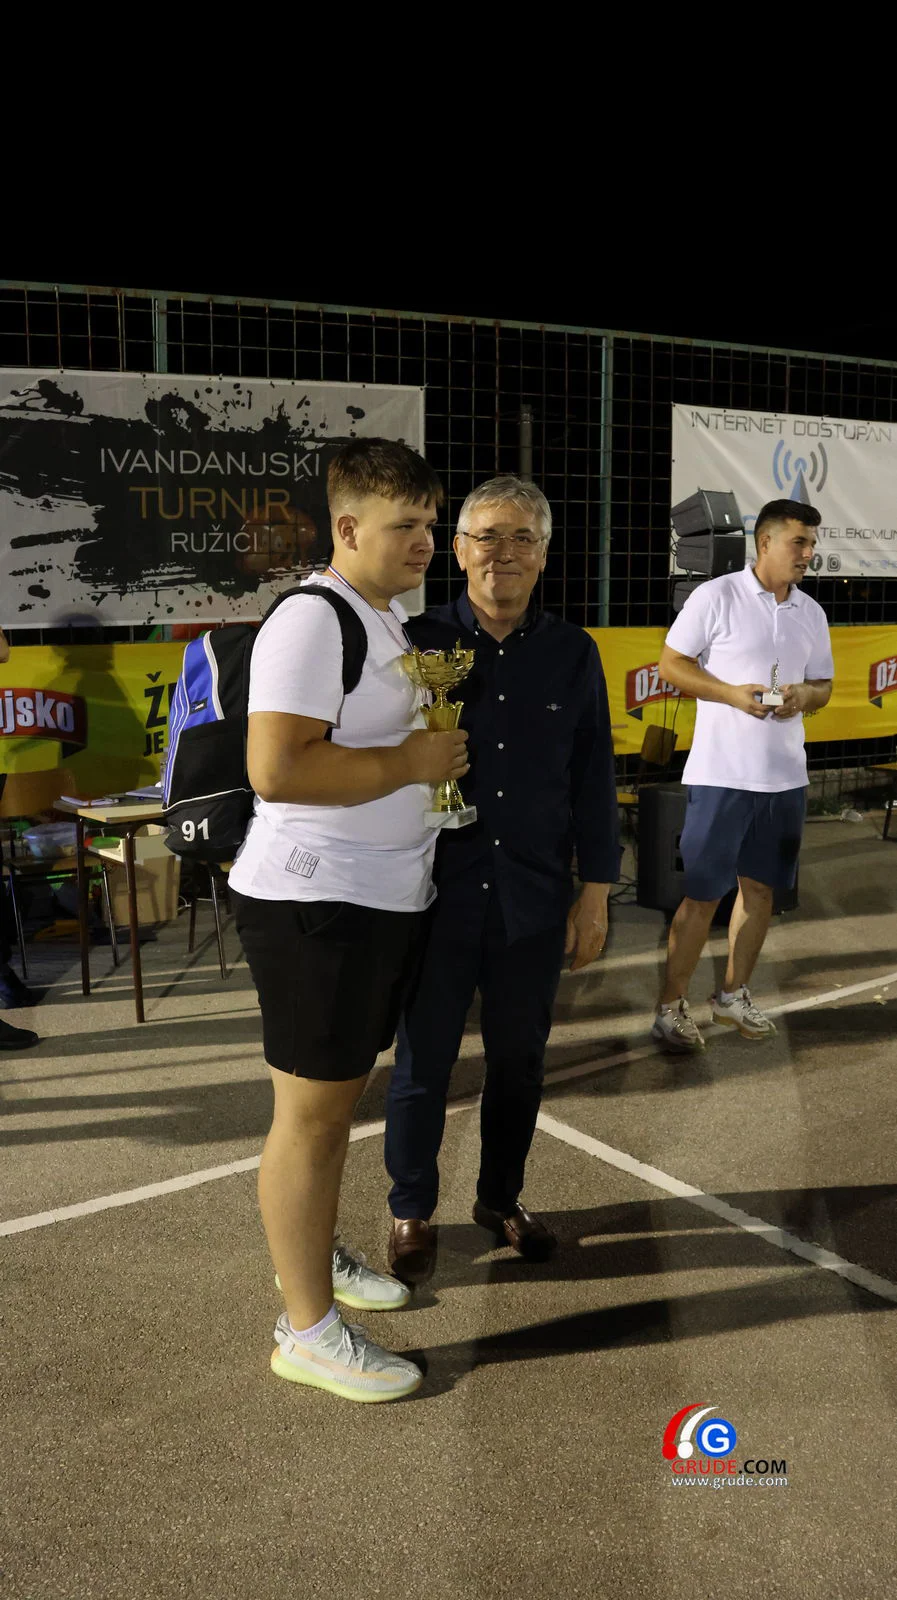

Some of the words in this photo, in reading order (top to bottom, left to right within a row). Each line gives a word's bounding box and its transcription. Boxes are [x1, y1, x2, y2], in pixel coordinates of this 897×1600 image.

[691, 411, 787, 434] INTERNET
[793, 420, 892, 442] DOSTUPAN
[100, 448, 320, 477] IVANDANJSKI
[129, 486, 290, 519] TURNIR
[171, 523, 258, 552] RUŽIĆI
[143, 731, 164, 757] JE
[181, 818, 209, 842] 91
